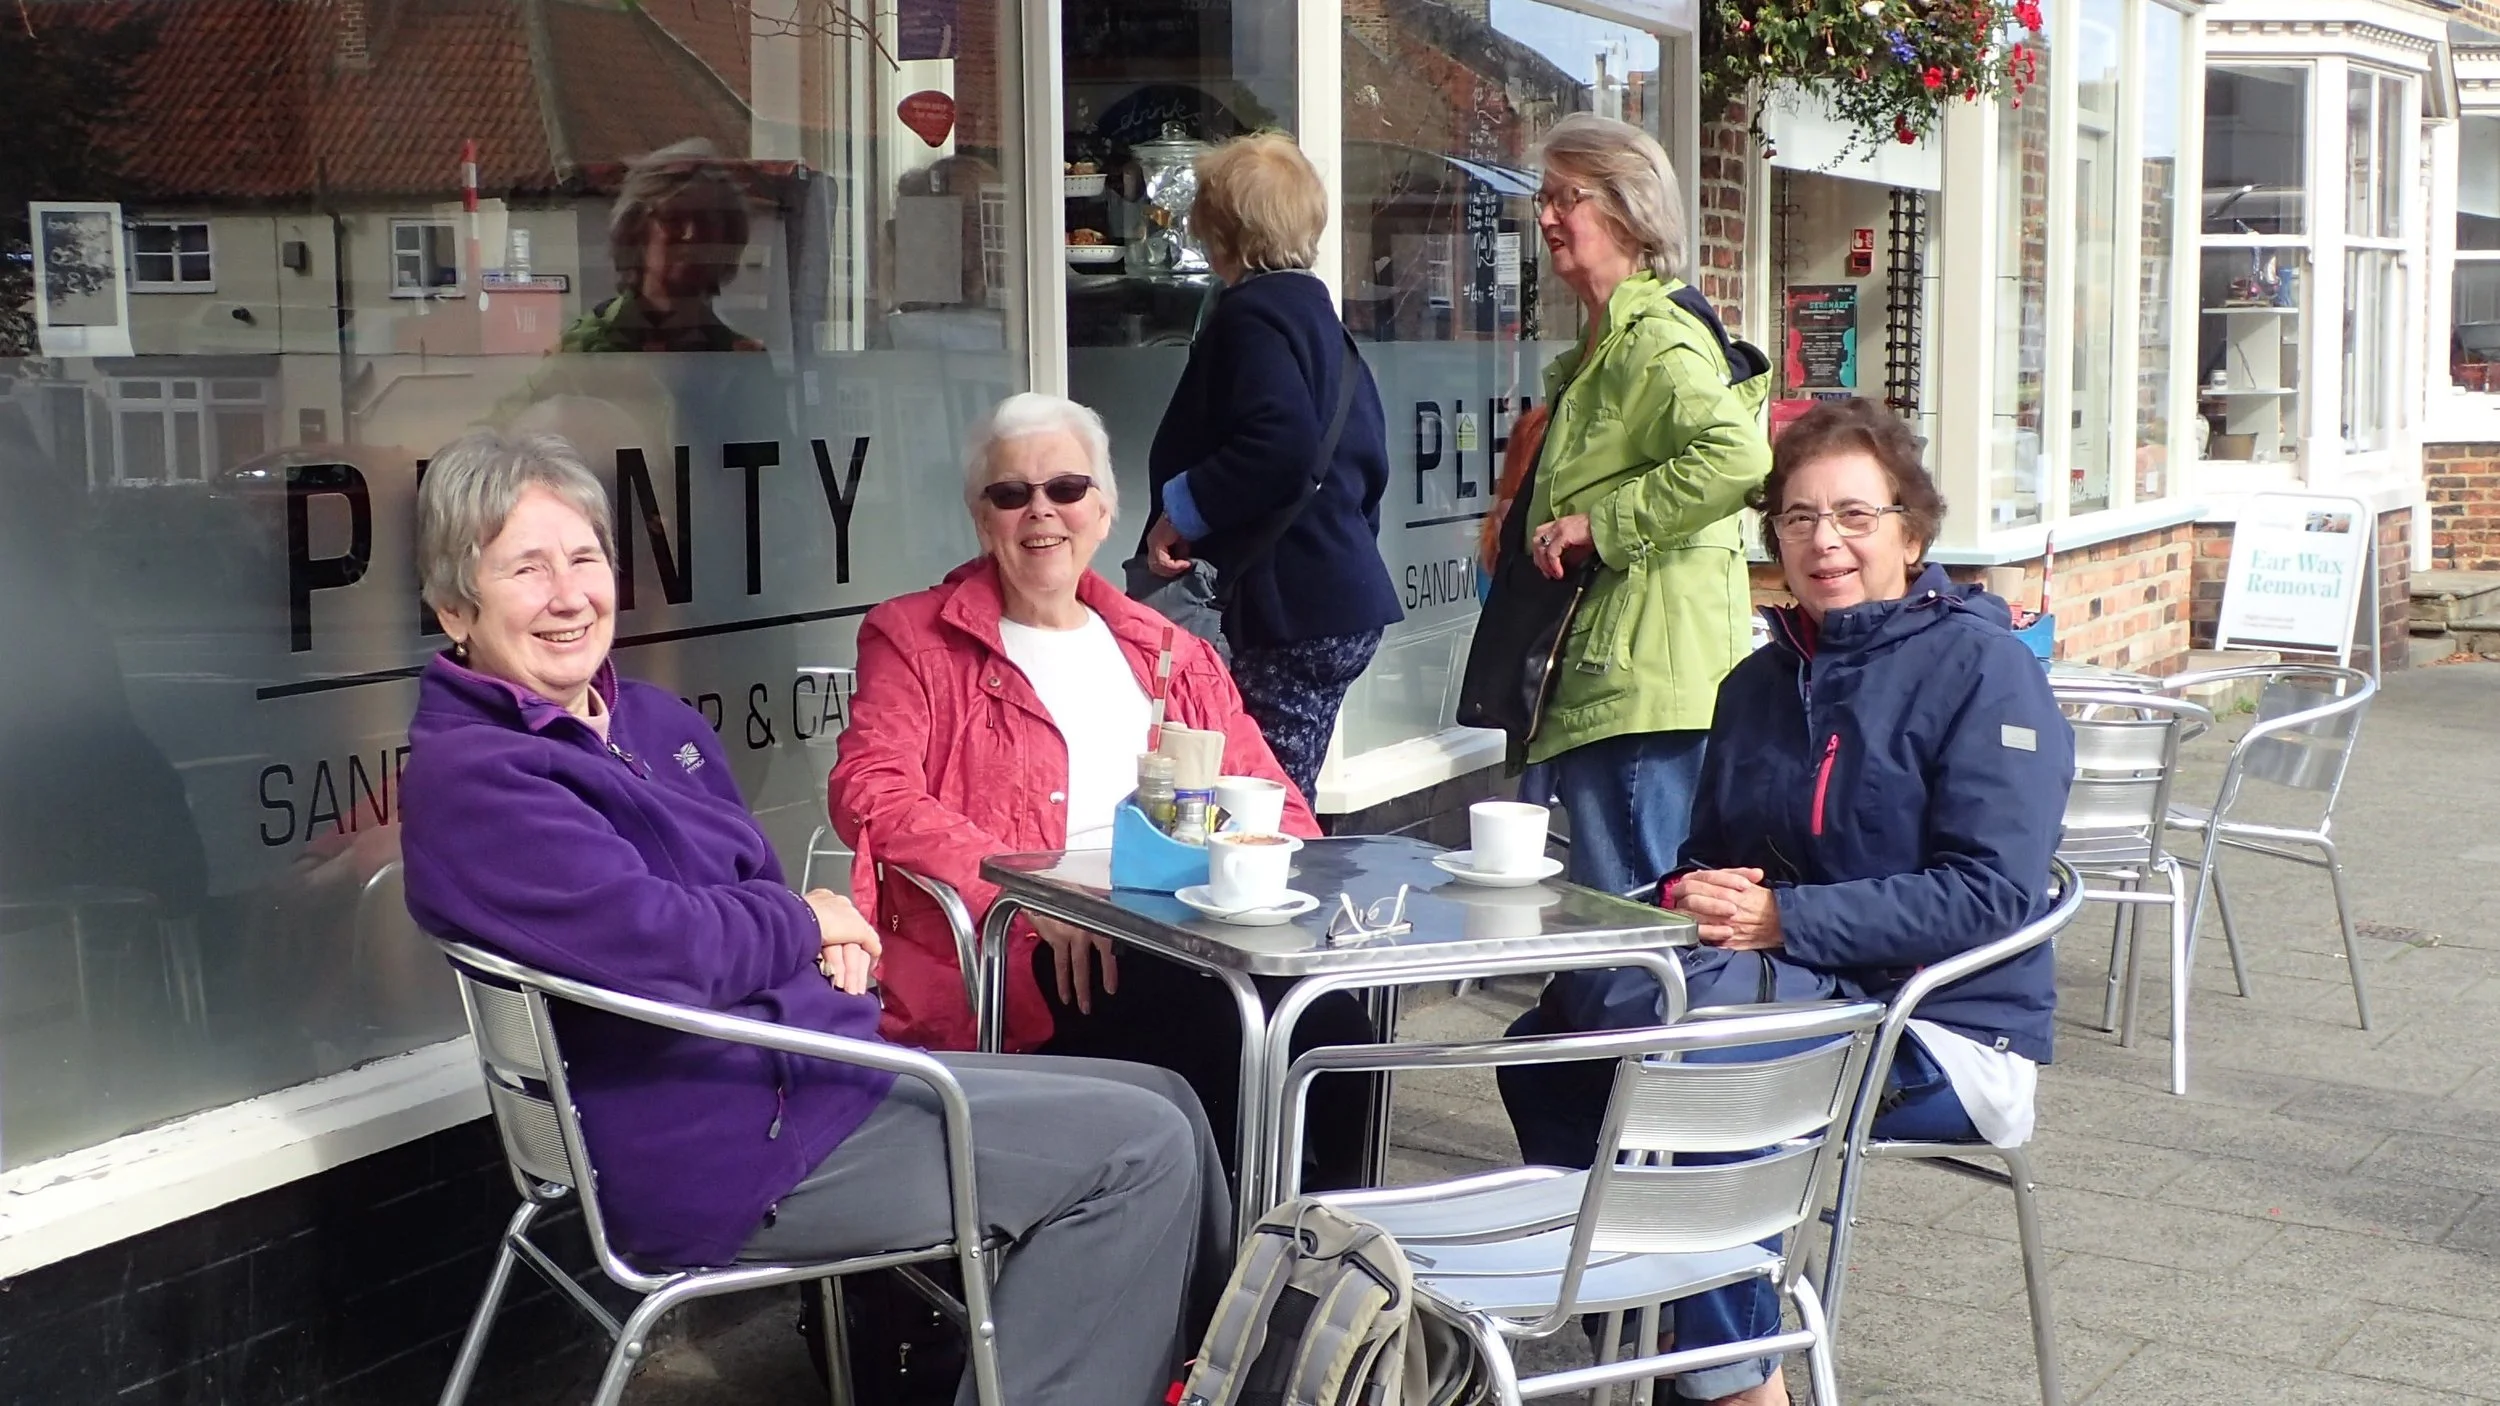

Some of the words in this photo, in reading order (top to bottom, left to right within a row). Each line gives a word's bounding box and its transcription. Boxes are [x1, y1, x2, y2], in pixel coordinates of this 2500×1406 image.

[1416, 396, 1532, 504] PLE
[286, 437, 870, 653] PNTY
[2250, 549, 2291, 571] Ear
[2297, 552, 2345, 575] Wax
[2246, 573, 2342, 599] Removal
[746, 683, 775, 750] &
